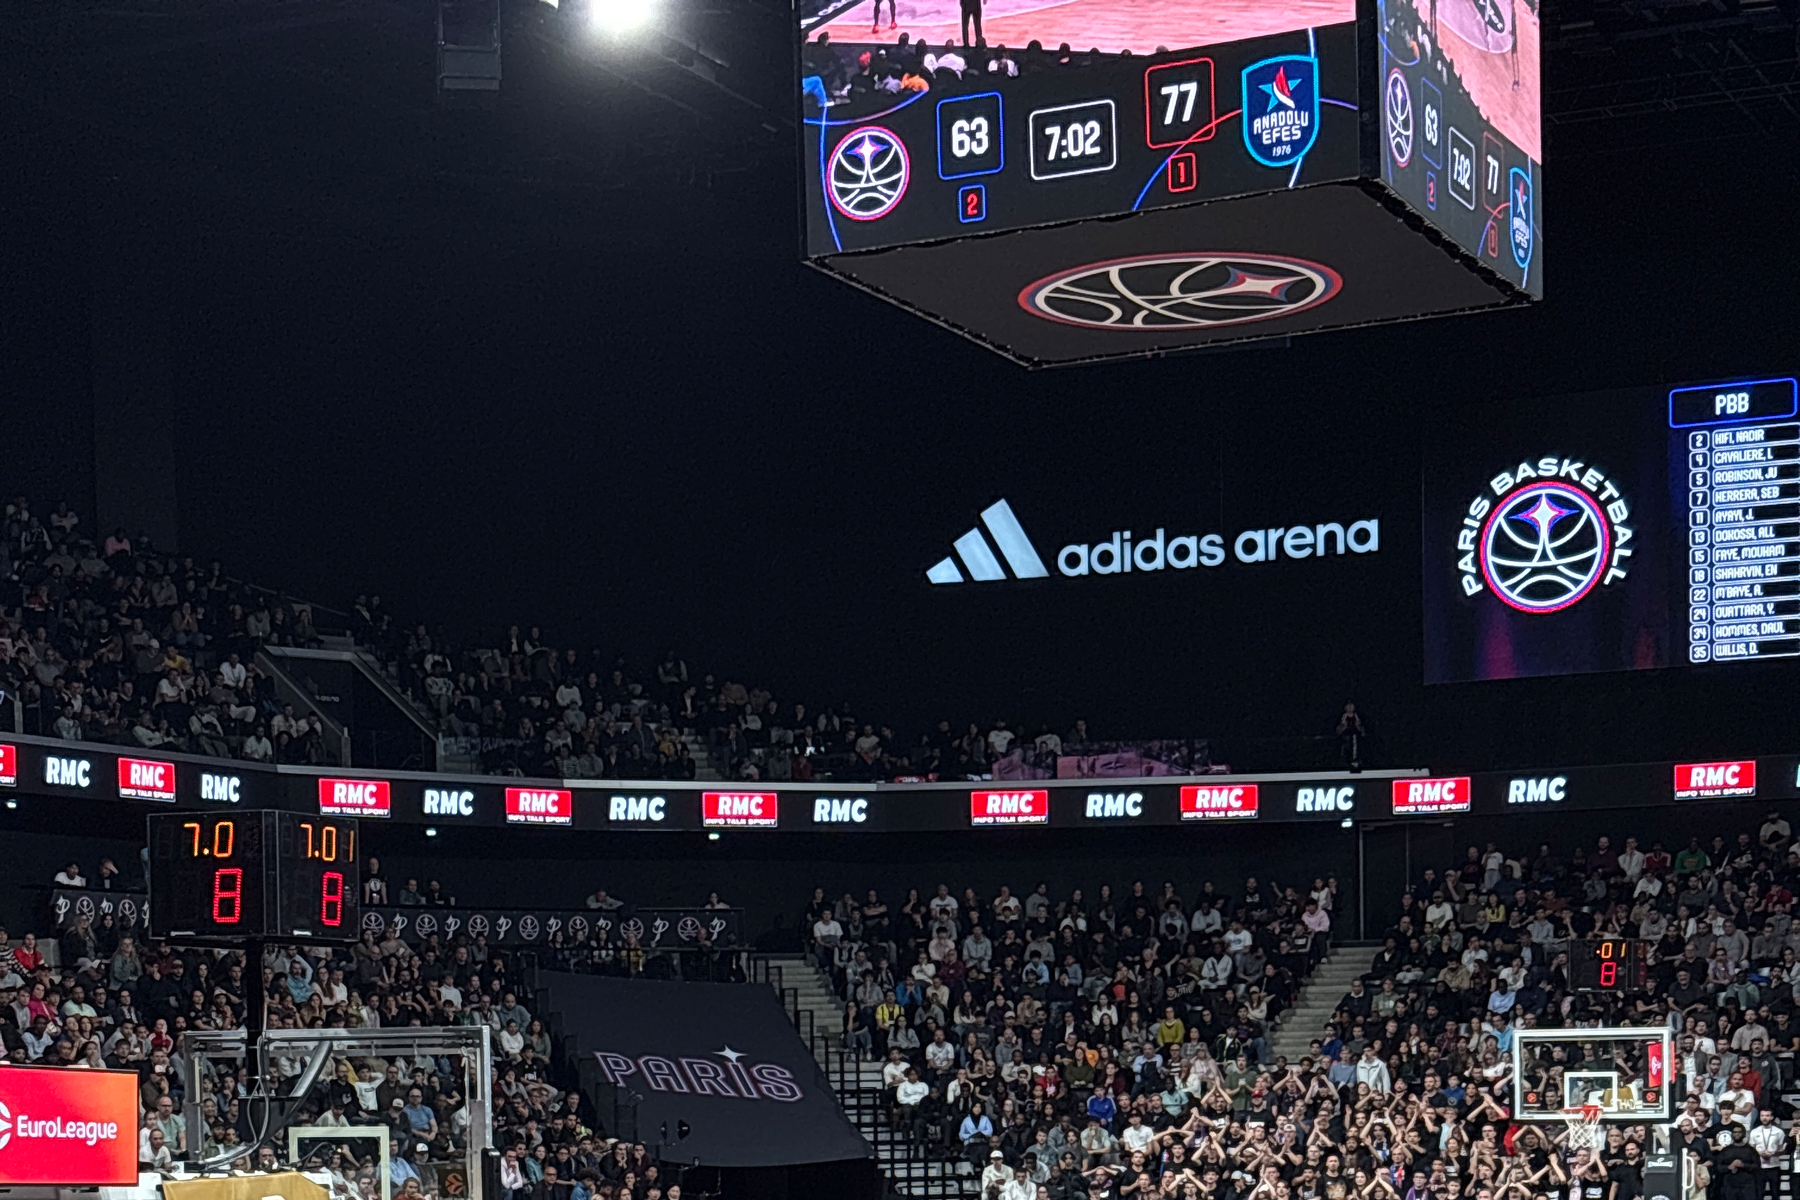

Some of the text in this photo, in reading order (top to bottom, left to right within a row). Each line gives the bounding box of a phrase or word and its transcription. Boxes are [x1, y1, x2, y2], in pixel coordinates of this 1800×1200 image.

[1161, 81, 1197, 125] 77
[1253, 110, 1309, 135] ANADOLU
[1425, 104, 1438, 146] 63
[952, 116, 988, 157] 63
[1045, 120, 1100, 161] 7:02
[1262, 126, 1302, 145] EFES
[1272, 145, 1291, 157] 1976
[1177, 162, 1186, 183] 1
[1452, 148, 1471, 191] 7:02
[1487, 154, 1499, 194] 77
[966, 193, 978, 215] 2
[1715, 392, 1749, 415] PBB
[1696, 429, 1765, 447] 2 HIFI, NADIR
[1696, 455, 1703, 466] 4
[1715, 448, 1766, 464] CAVALIERE,
[1696, 466, 1778, 485] 5 ROBINSON, JU
[1696, 486, 1780, 505] 7 HERRERA, SEB
[1457, 458, 1633, 597] PARIS BASKETBALL
[1695, 512, 1703, 524] 11
[1716, 509, 1744, 523] AYAYI,
[1695, 526, 1775, 543] 13 DOKOSSI, ALL
[1057, 518, 1379, 577] adidas arena
[1695, 544, 1785, 562] 15 FAYE, MOUHAM
[1716, 565, 1764, 580] SHAHRVIN,
[1765, 564, 1778, 576] EN
[1693, 589, 1706, 601] 22
[1693, 609, 1706, 620] 24
[1716, 604, 1766, 618] OUATTARA,
[1693, 622, 1785, 639] 34 HOMMES, DAUL
[1693, 647, 1706, 658] 35
[1716, 643, 1748, 656] WILLIS,
[45, 756, 91, 788] RMC
[130, 763, 165, 788] RMC
[1690, 765, 1741, 787] RMC
[201, 773, 240, 803] RMC
[333, 783, 377, 805] RMC
[1195, 788, 1244, 808] RMC
[1296, 787, 1354, 812] RMC
[1408, 781, 1456, 802] RMC
[1508, 777, 1567, 803] RMC
[423, 789, 474, 816] RMC
[519, 792, 559, 813] RMC
[609, 796, 666, 821] RMC
[717, 796, 763, 815] RMC
[813, 798, 868, 823] RMC
[986, 794, 1034, 814] RMC
[1085, 793, 1143, 818] RMC
[184, 822, 233, 857] 7.0
[213, 868, 243, 924] 8
[321, 872, 343, 926] 8
[1600, 962, 1616, 986] 8
[593, 1050, 803, 1102] PARIS
[17, 1115, 117, 1146] EuroLeague
